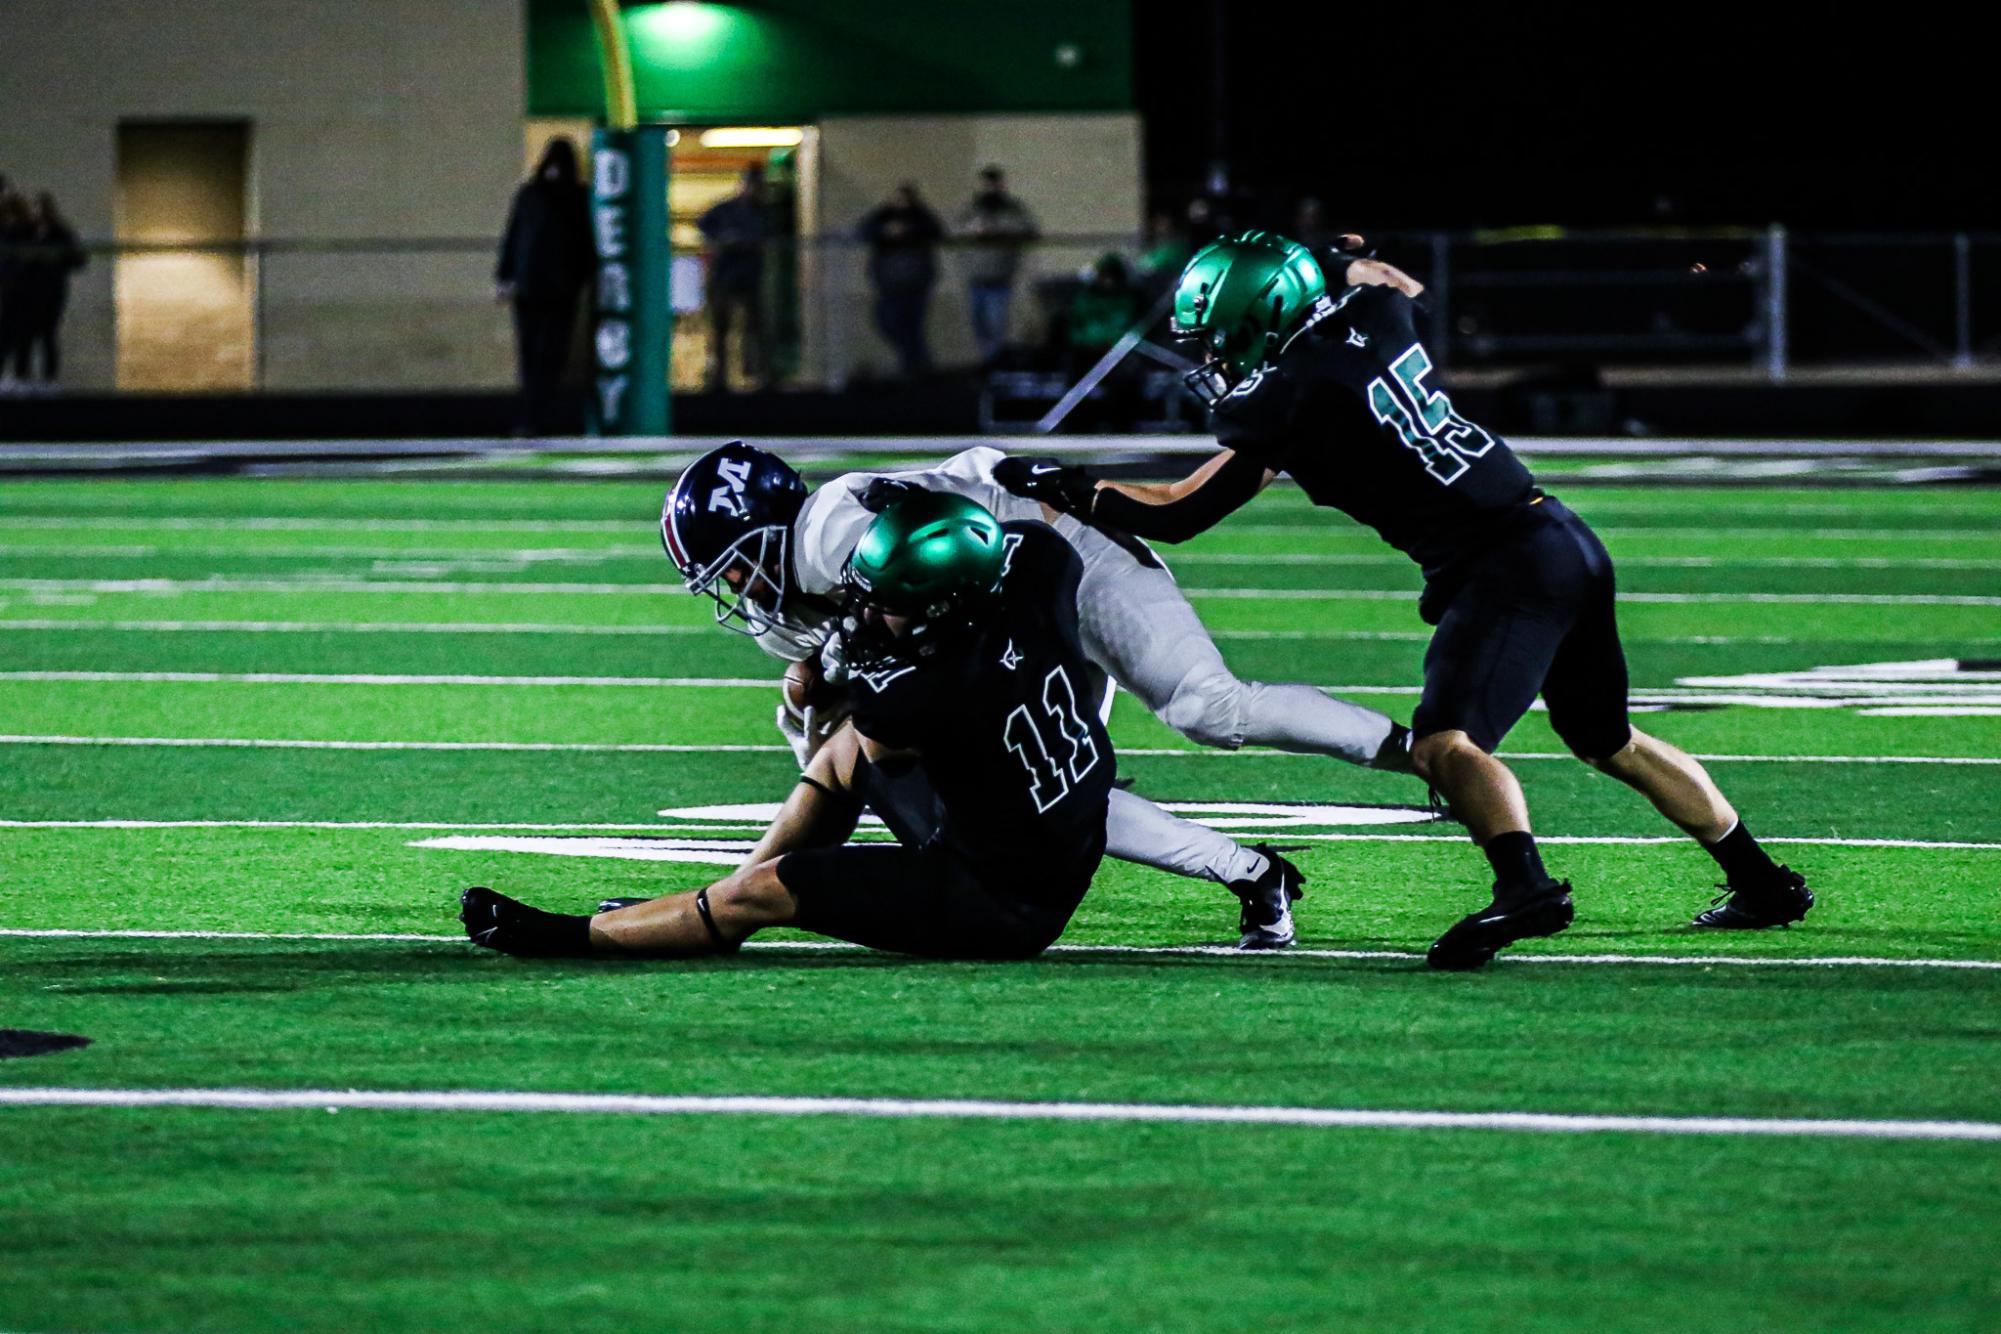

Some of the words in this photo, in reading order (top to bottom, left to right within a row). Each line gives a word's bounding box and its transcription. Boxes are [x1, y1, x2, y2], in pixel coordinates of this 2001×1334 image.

[1367, 342, 1496, 486] 15
[708, 457, 752, 518] M
[1003, 664, 1099, 814] 11
